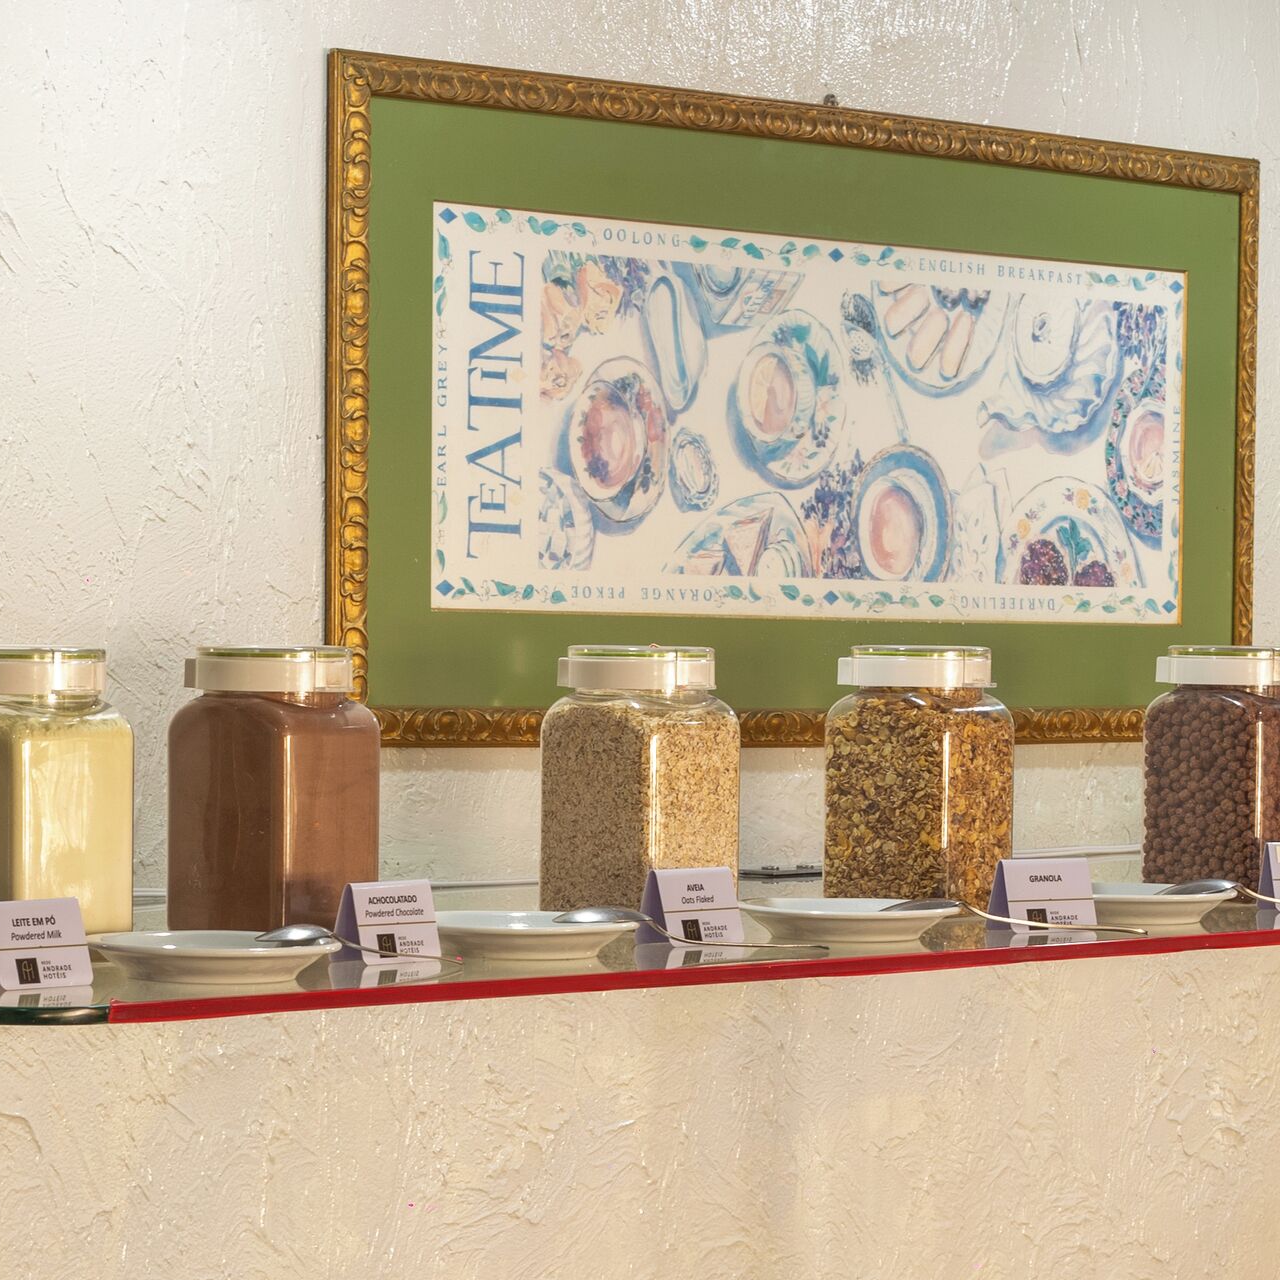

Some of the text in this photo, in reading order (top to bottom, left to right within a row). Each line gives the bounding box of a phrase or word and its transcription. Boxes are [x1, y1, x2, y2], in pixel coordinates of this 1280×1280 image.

[603, 228, 681, 248] OOLONG
[919, 257, 1083, 285] ENGLISH BREAKFAST
[436, 344, 448, 486] EARL GREY
[1171, 406, 1180, 505] JASMINE
[571, 585, 713, 601] ORANGE PEKOE
[960, 595, 1056, 611] DARJEELING
[1029, 874, 1063, 883] GRANOLA
[687, 883, 704, 892] AVEIA
[368, 895, 417, 905] ACHOCOLATADO
[681, 895, 714, 904] Oats Flaked
[365, 908, 424, 918] Powdered Chocolate
[12, 915, 56, 927] LEITE EM PÓ
[11, 930, 62, 941] Powdered Milk
[42, 964, 72, 972] ANDRADE
